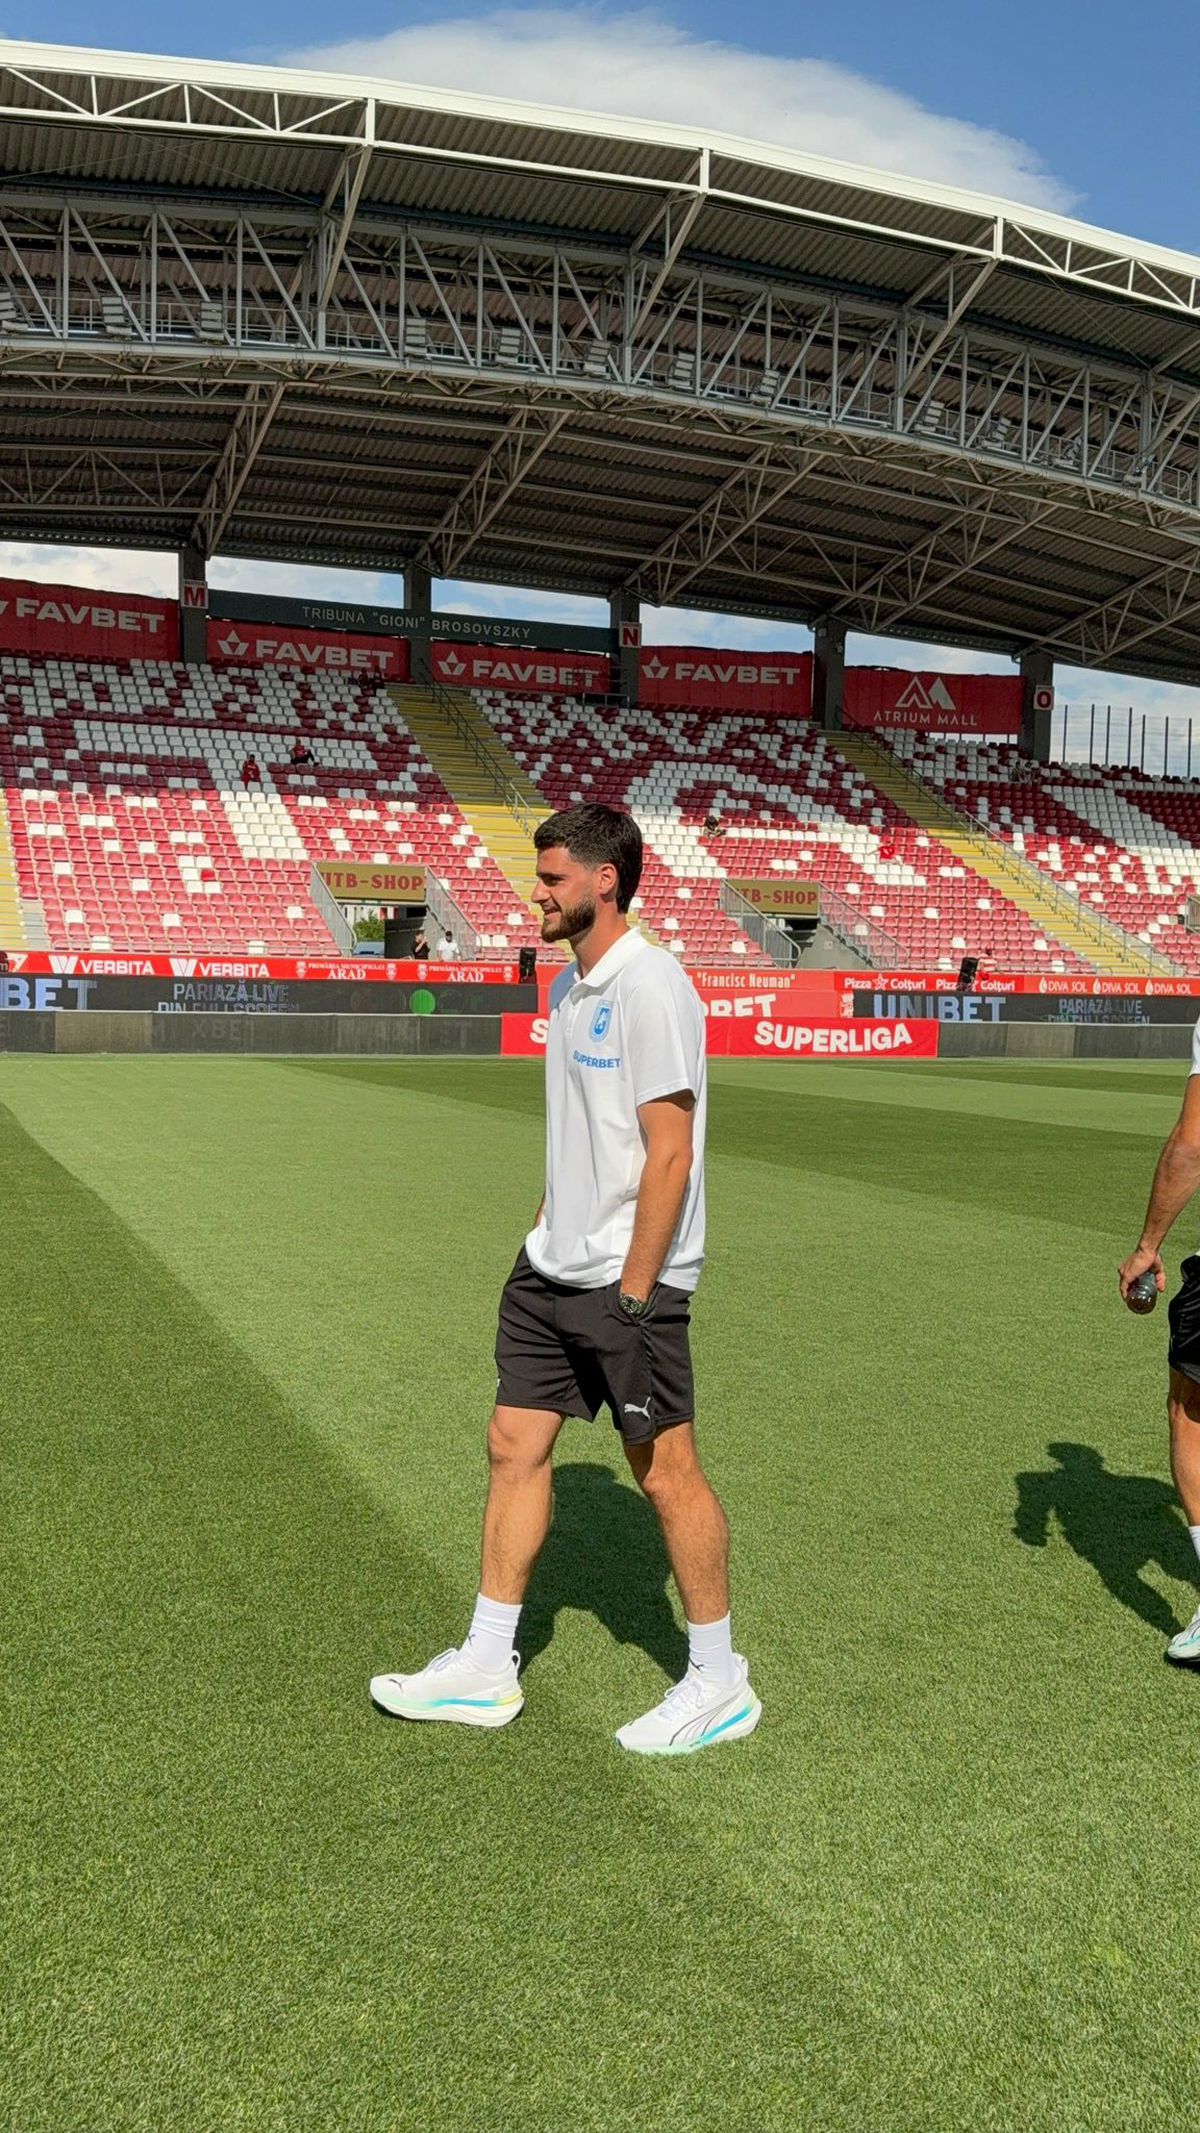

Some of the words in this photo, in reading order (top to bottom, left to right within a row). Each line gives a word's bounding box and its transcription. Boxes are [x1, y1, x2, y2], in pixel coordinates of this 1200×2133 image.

[183, 585, 205, 607] M
[16, 597, 165, 633] FAVBET
[303, 606, 365, 623] TRIBUNA
[373, 612, 425, 628] "GIONI"
[432, 620, 530, 638] BROSOVSZKY
[623, 627, 638, 646] N
[256, 640, 394, 669] FAVBET
[473, 660, 600, 688] FAVBET
[675, 663, 801, 685] FAVBET
[873, 709, 931, 725] ATRIUM
[937, 713, 978, 726] MALL
[736, 888, 817, 905] TB-SHOP
[80, 959, 155, 975] VERBITA
[199, 963, 270, 978] VERBITA
[328, 969, 366, 980] ARAD
[448, 971, 484, 982] ARAD
[844, 978, 871, 989] Pizza
[936, 979, 960, 990] Pizz
[1048, 981, 1069, 991] DIVA
[1071, 982, 1087, 992] SOL
[1102, 982, 1122, 992] DIVA
[1124, 983, 1140, 993] SOL
[1154, 983, 1174, 993] DIVA
[1176, 984, 1192, 994] SOL
[873, 993, 1006, 1021] UNIBET
[754, 1020, 912, 1053] SUPERLIGA
[573, 1050, 621, 1069] SUPERBET
